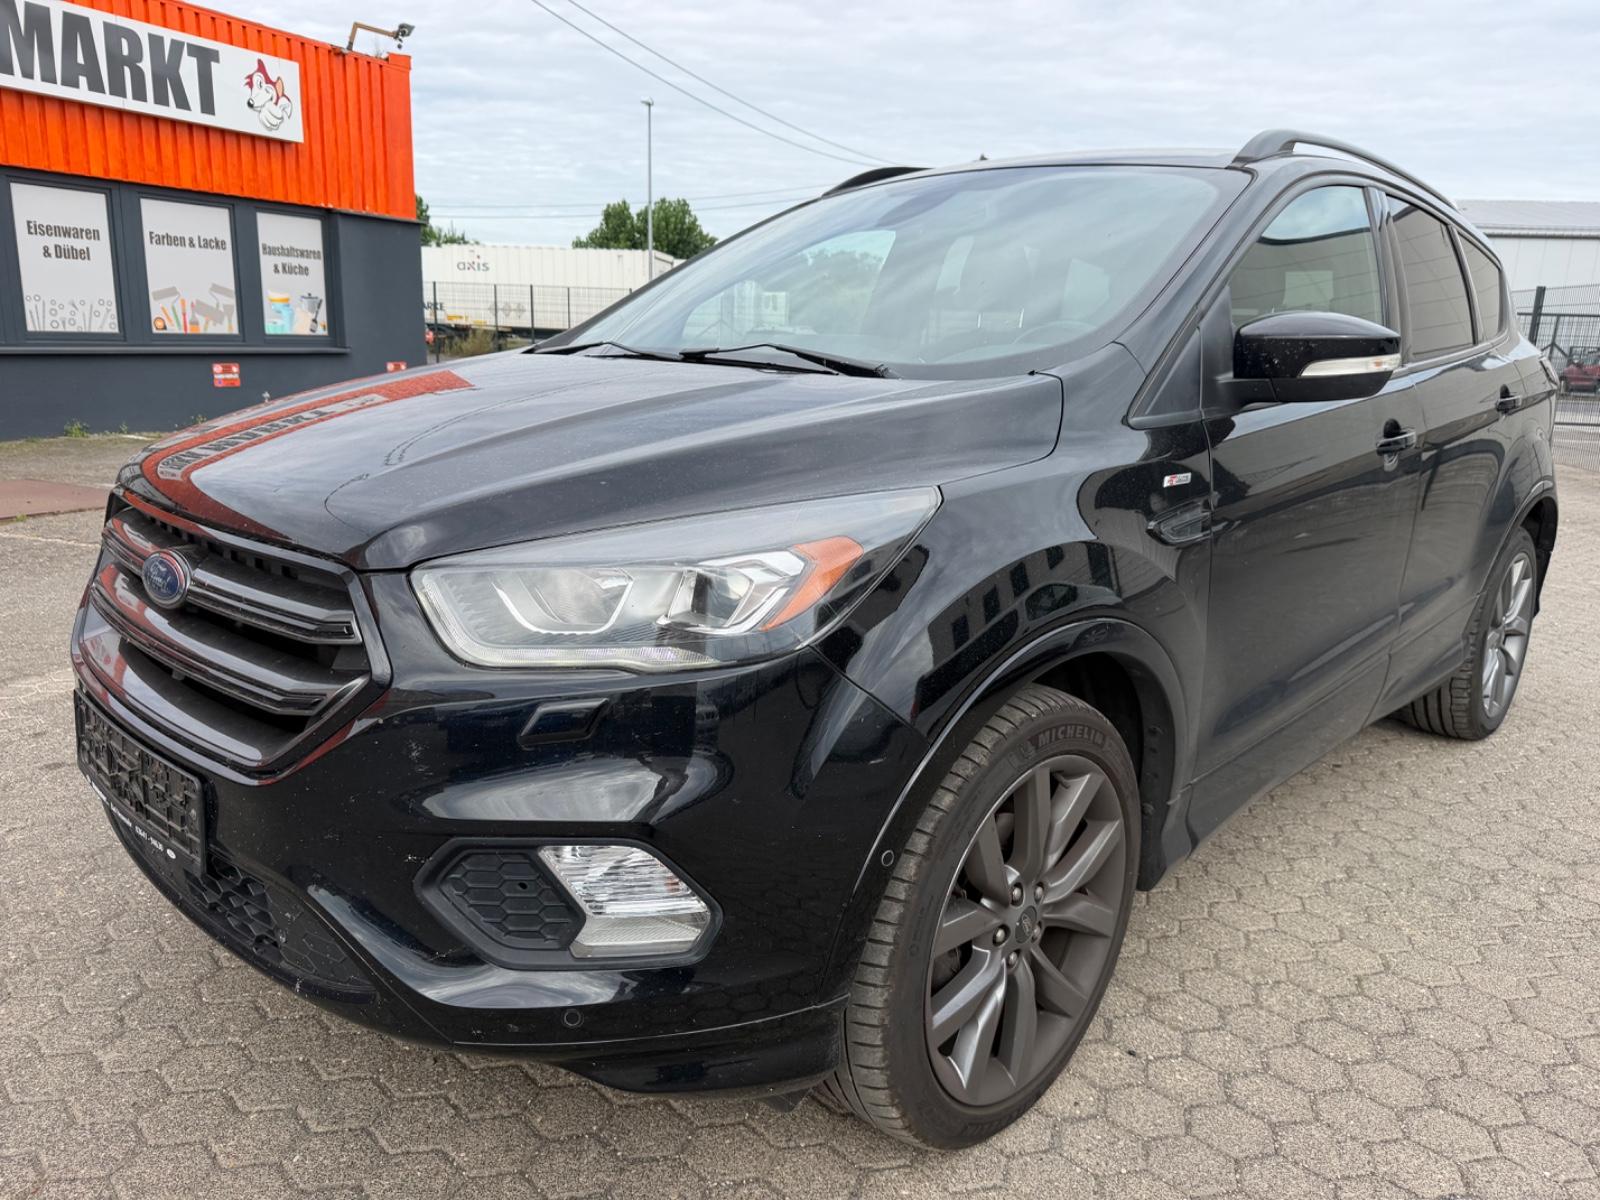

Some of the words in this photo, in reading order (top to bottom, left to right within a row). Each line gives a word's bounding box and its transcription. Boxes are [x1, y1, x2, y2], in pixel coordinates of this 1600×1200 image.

[0, 0, 220, 116] MARKT
[26, 220, 101, 241] Eisenwaren
[149, 231, 187, 248] Farben
[188, 236, 196, 249] &
[197, 234, 227, 251] Lacke
[42, 245, 52, 258] &
[54, 244, 91, 261] Dübel
[456, 254, 490, 271] axis
[273, 263, 280, 274] &
[281, 261, 309, 276] Küche
[1039, 724, 1106, 747] MICHELIN
